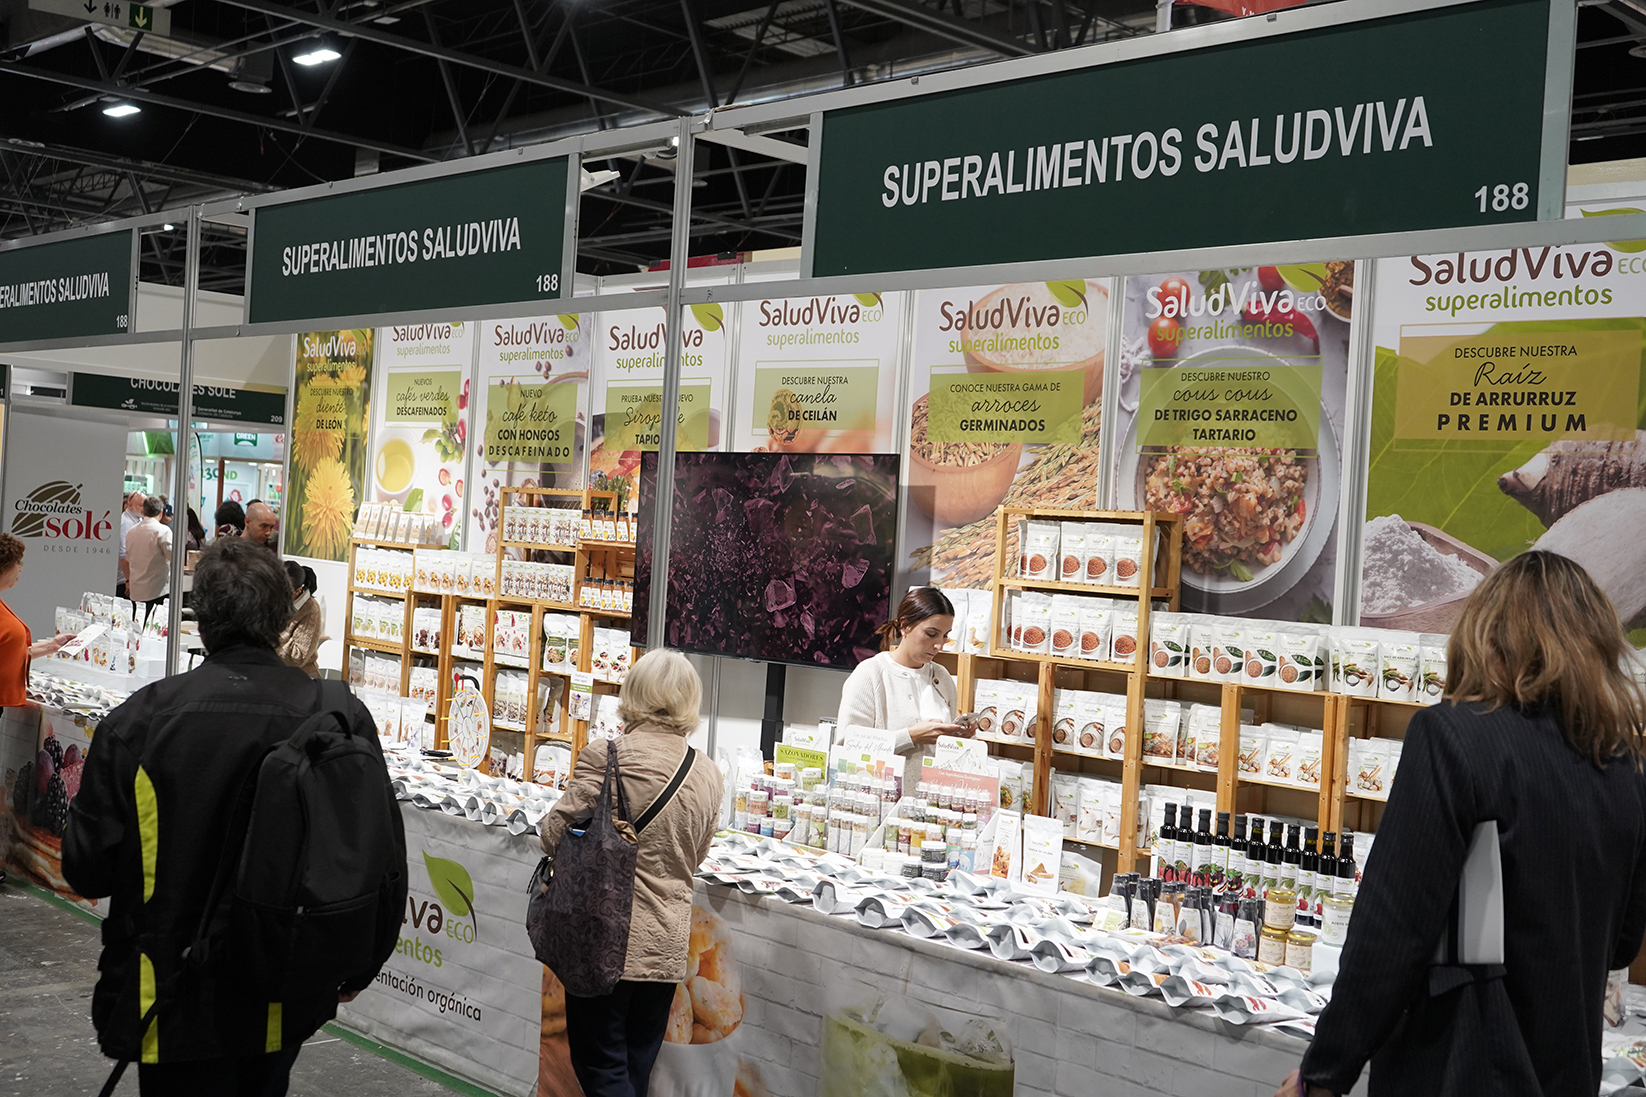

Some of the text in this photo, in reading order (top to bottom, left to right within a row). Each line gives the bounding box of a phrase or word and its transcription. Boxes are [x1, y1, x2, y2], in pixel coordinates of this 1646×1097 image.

[882, 96, 1433, 208] SUPERALIMENTOS SALUDVIVA
[1474, 182, 1529, 213] 188
[282, 217, 521, 276] SUPERALIMENTOS SALUDVIVA
[1409, 246, 1613, 286] SaludViva
[0, 272, 110, 308] ERALIMENTOS SALUDVIVA
[535, 274, 559, 293] 188
[1145, 280, 1327, 319] SaludViva ECO
[1425, 285, 1613, 317] superalimentos
[758, 297, 882, 327] SaludViva ECO
[939, 296, 1086, 332] SaludViva ECO
[116, 315, 128, 328] 188
[392, 323, 464, 342] SaludViva ECO
[494, 321, 580, 347] SaludViva ECO
[608, 323, 704, 351] Saludva
[766, 328, 860, 350] superalimentos
[1156, 319, 1294, 346] superalimentos
[303, 335, 357, 358] SaludViva
[396, 343, 451, 359] superalimentos
[948, 333, 1060, 358] superalimentos
[1454, 345, 1577, 359] DESCUBRE NUESTRA
[499, 347, 564, 364] superalimentos
[616, 352, 704, 373] superalitos
[306, 359, 356, 374] superalimentos
[1474, 361, 1547, 387] Raíz
[413, 378, 433, 386] NUEVOS
[781, 376, 849, 385] DESCUBRE NUESTRA
[1181, 371, 1271, 382] DESCUBRE NUESTRO
[130, 377, 205, 397] CHOCOLES
[309, 387, 354, 396] DESCUBRE NUESTRO
[396, 385, 450, 405] cafés verdes
[520, 389, 542, 398] NUEVO
[789, 384, 837, 404] canela
[950, 382, 1061, 393] CONOCE NUESTRA GAMA DE
[1173, 387, 1273, 402] cous cous
[316, 397, 345, 413] diente
[621, 394, 642, 403] PRUEBA
[643, 393, 663, 403] NUEST
[971, 399, 1042, 413] arroces
[1450, 391, 1577, 406] DE ARRURRUZ
[270, 415, 283, 423] 209
[396, 406, 448, 416] DESCAFEINADOS
[502, 402, 558, 429] café keto
[623, 406, 662, 431] Sirop
[788, 407, 838, 421] DE CEILÁN
[1154, 409, 1298, 422] DE TRIGO SARRACENO
[316, 416, 343, 429] DE LEÓN
[959, 419, 1046, 432] GERMINADOS
[1437, 414, 1587, 432] PREMIUM
[497, 429, 560, 441] CON HONGOS
[635, 433, 661, 445] TAPIO
[1193, 428, 1256, 441] TARTARIO
[488, 446, 570, 458] DESCAFEINADO
[15, 499, 83, 515] Chocolates
[45, 510, 112, 541] solé
[44, 545, 78, 553] DESDE
[779, 748, 824, 761] SAZONADORES
[446, 919, 474, 944] ECO
[376, 970, 482, 1022] entación orgánica
